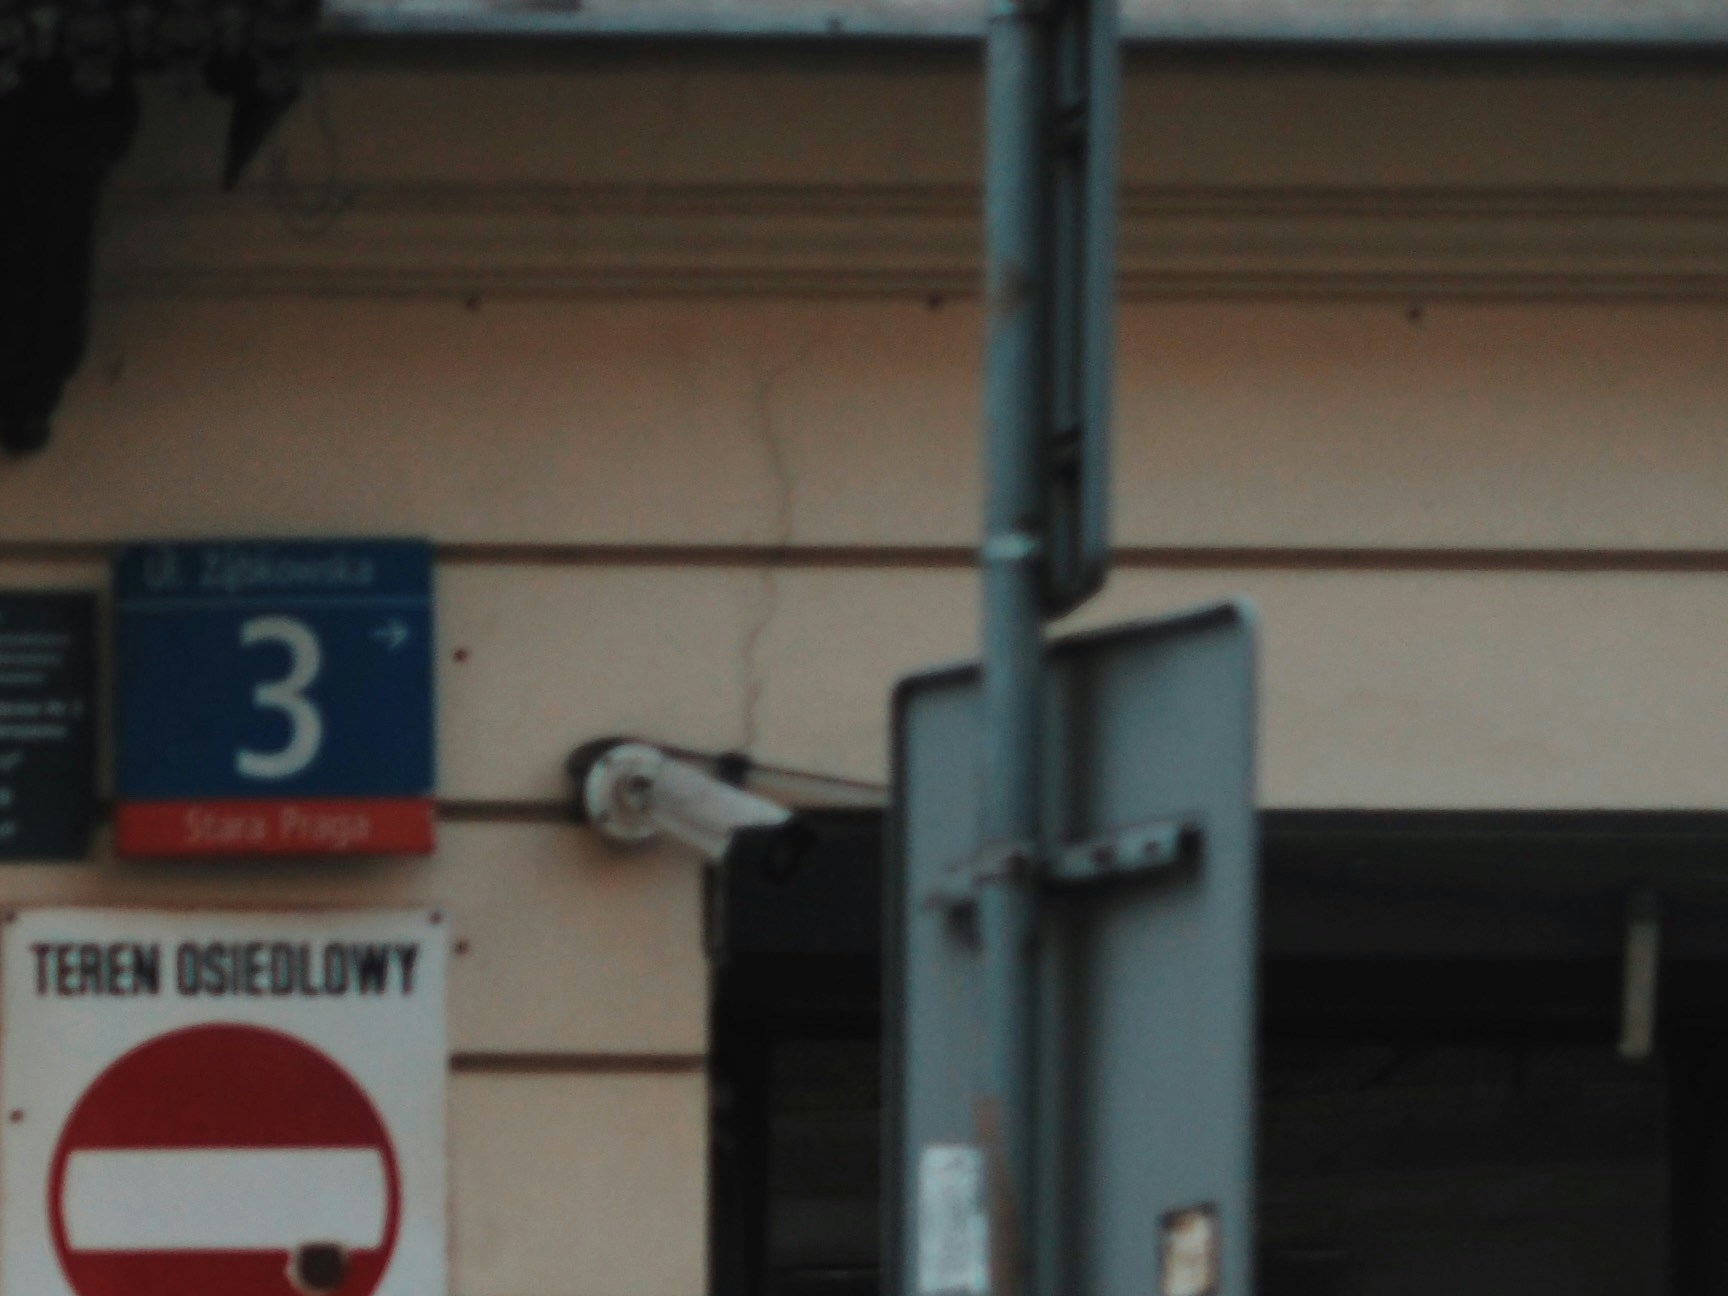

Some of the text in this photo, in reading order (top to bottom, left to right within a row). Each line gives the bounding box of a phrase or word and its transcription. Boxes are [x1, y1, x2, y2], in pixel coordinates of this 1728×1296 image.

[234, 614, 324, 782] 3
[184, 806, 371, 848] Stara Praga
[31, 942, 161, 997] TEREN
